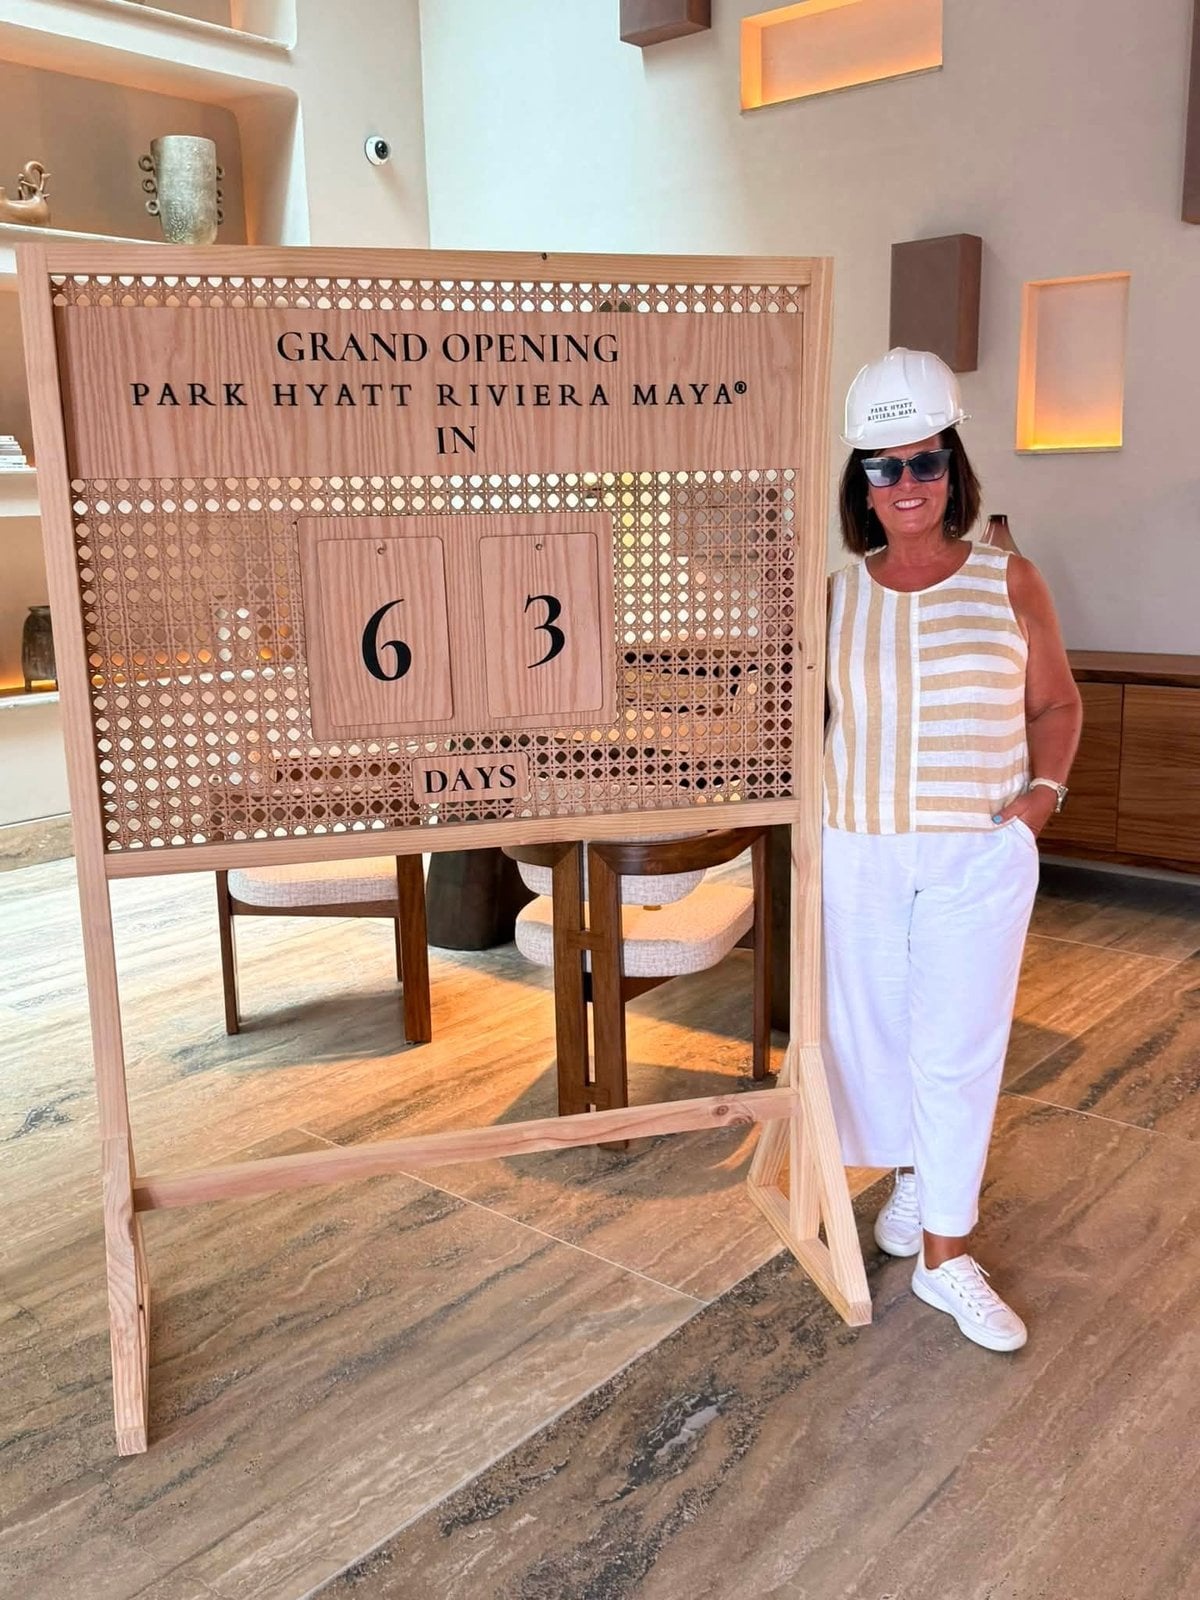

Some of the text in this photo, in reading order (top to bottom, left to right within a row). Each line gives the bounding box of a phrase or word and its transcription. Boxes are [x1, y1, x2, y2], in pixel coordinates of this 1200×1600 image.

[276, 331, 620, 363] GRAND OPENING
[130, 382, 249, 408] PARK
[272, 382, 413, 407] HYATT
[436, 382, 611, 407] RIVIERA
[870, 402, 913, 414] PARK HYATT
[867, 408, 917, 421] RIVIERA MAYA
[436, 425, 477, 455] IN
[361, 594, 566, 682] 6 3
[423, 763, 517, 794] DAYS
